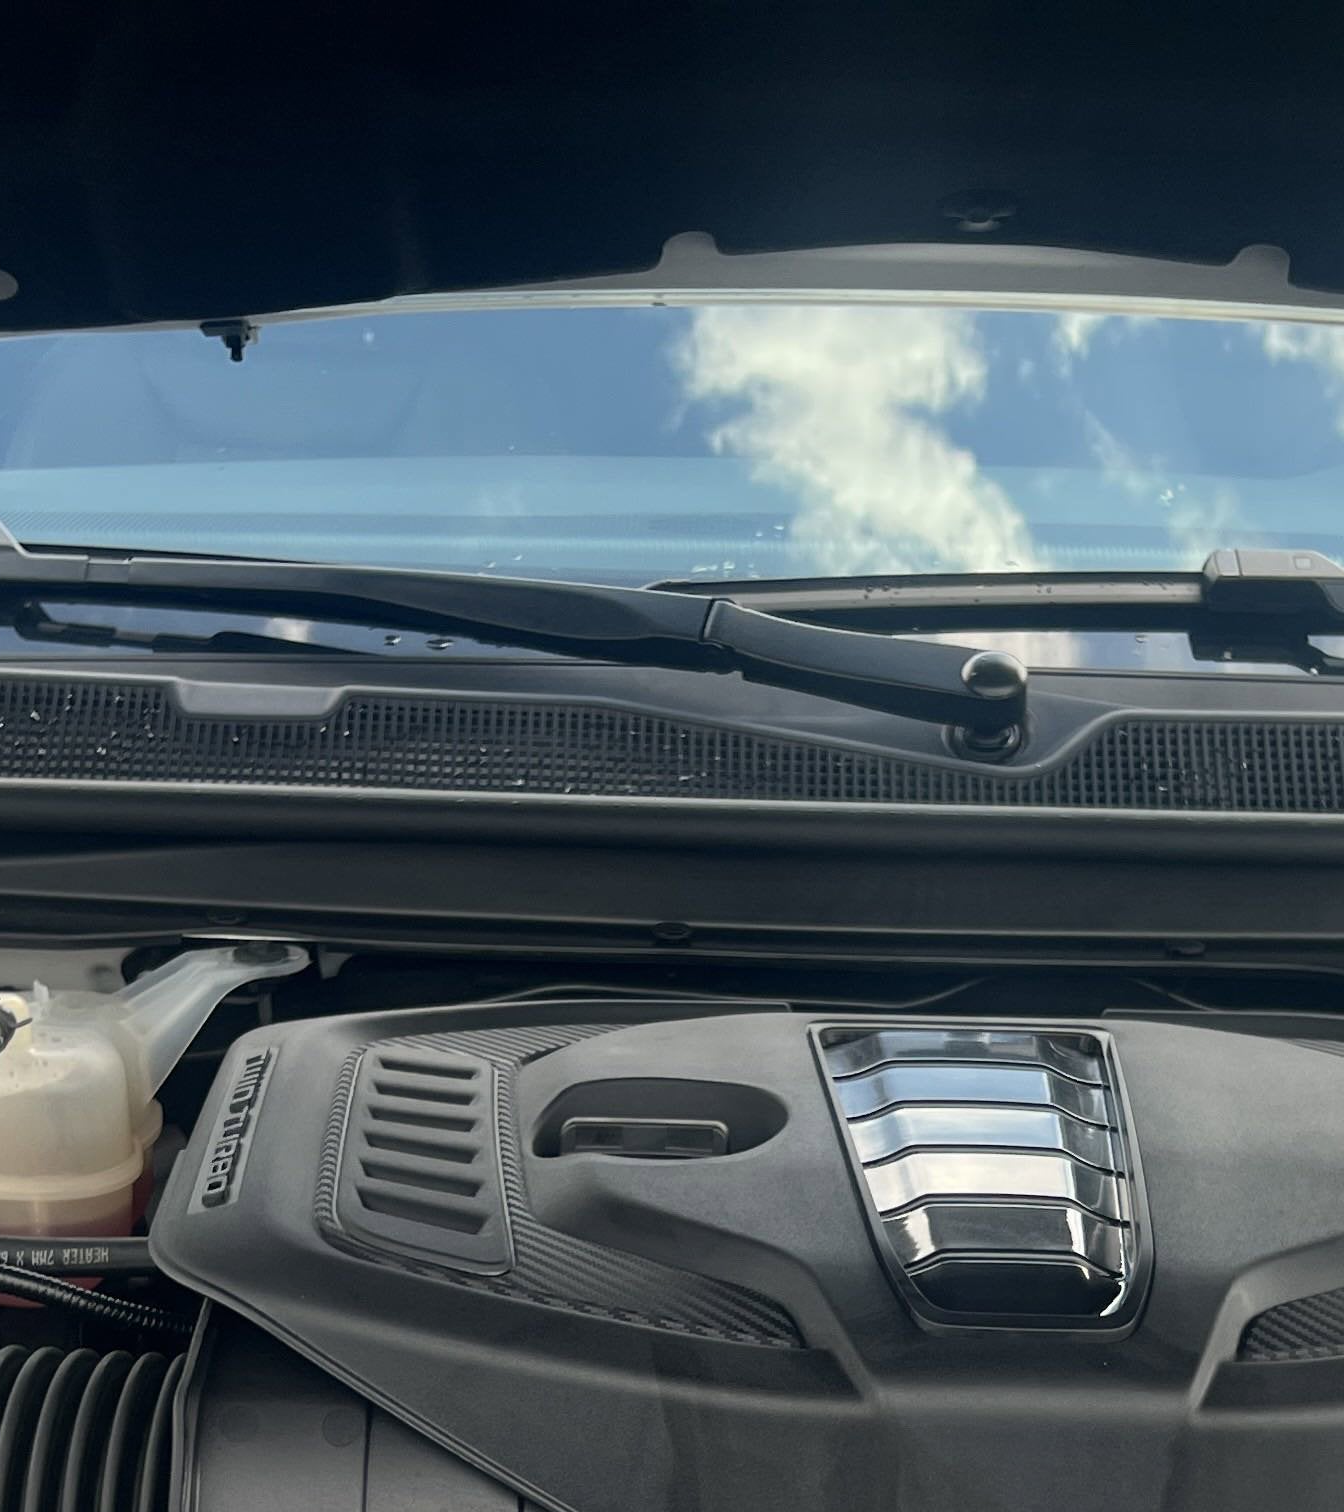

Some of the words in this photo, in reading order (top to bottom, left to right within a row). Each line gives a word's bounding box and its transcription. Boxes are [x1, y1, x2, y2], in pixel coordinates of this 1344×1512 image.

[231, 1048, 271, 1112] TWIN
[205, 1106, 251, 1202] TURBO
[15, 1249, 25, 1267] X
[31, 1248, 55, 1266] 7MM
[62, 1247, 110, 1266] HEATER
